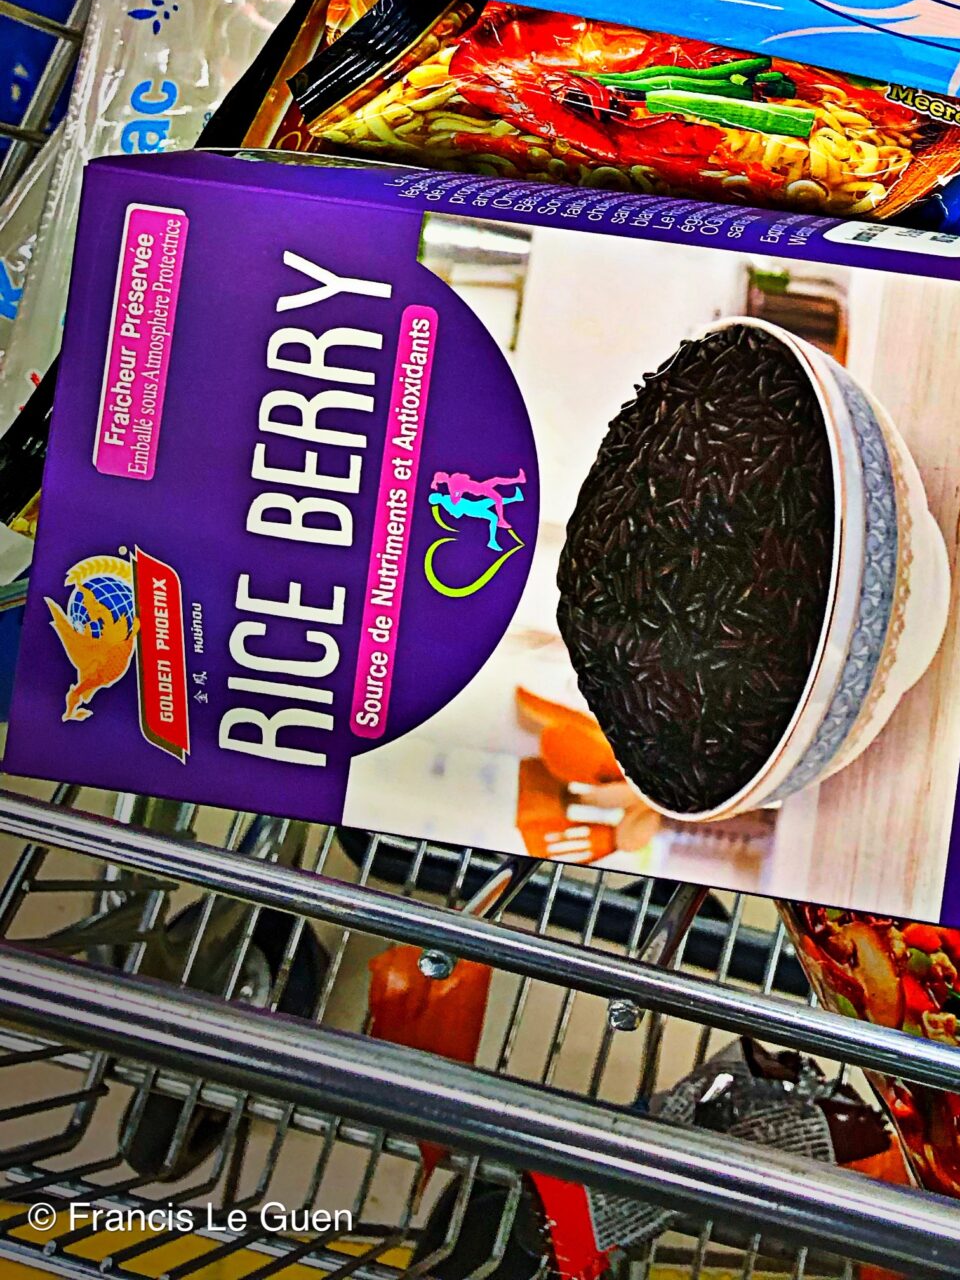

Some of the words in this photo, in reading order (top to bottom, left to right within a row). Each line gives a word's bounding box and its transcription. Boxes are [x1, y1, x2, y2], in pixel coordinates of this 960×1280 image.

[151, 219, 182, 293] Protectrice
[103, 345, 137, 446] Fraîcheur
[120, 233, 155, 339] Préservée
[141, 294, 171, 382] Atmosphère
[141, 383, 158, 415] sous
[246, 250, 393, 547] BERRY
[391, 318, 431, 451] Antioxidants
[127, 418, 154, 475] Emballé
[391, 457, 413, 481] et
[370, 488, 408, 607] Nutriments
[153, 577, 168, 650] PHOENIX
[367, 615, 393, 643] de
[158, 660, 171, 721] GOLDEN
[218, 573, 346, 767] RICE
[355, 651, 389, 727] Source
